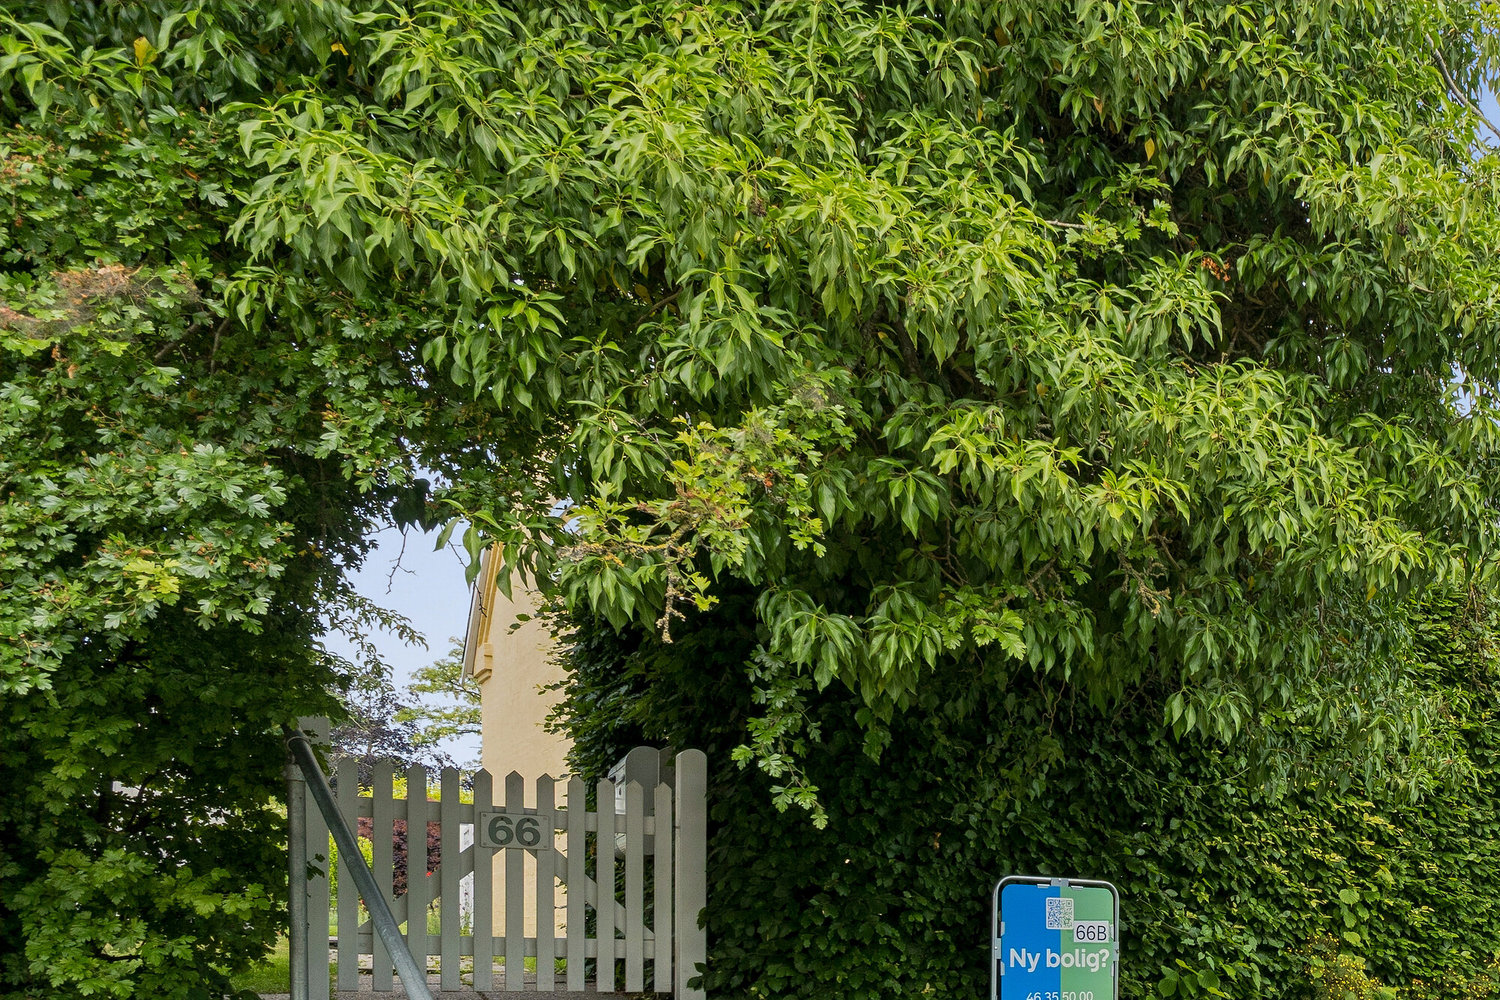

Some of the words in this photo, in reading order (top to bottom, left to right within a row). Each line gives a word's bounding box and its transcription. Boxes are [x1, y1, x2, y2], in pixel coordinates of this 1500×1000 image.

[488, 816, 541, 846] 66
[1076, 925, 1107, 941] 66B
[1009, 948, 1041, 973] Ny
[1046, 948, 1110, 973] bolig?
